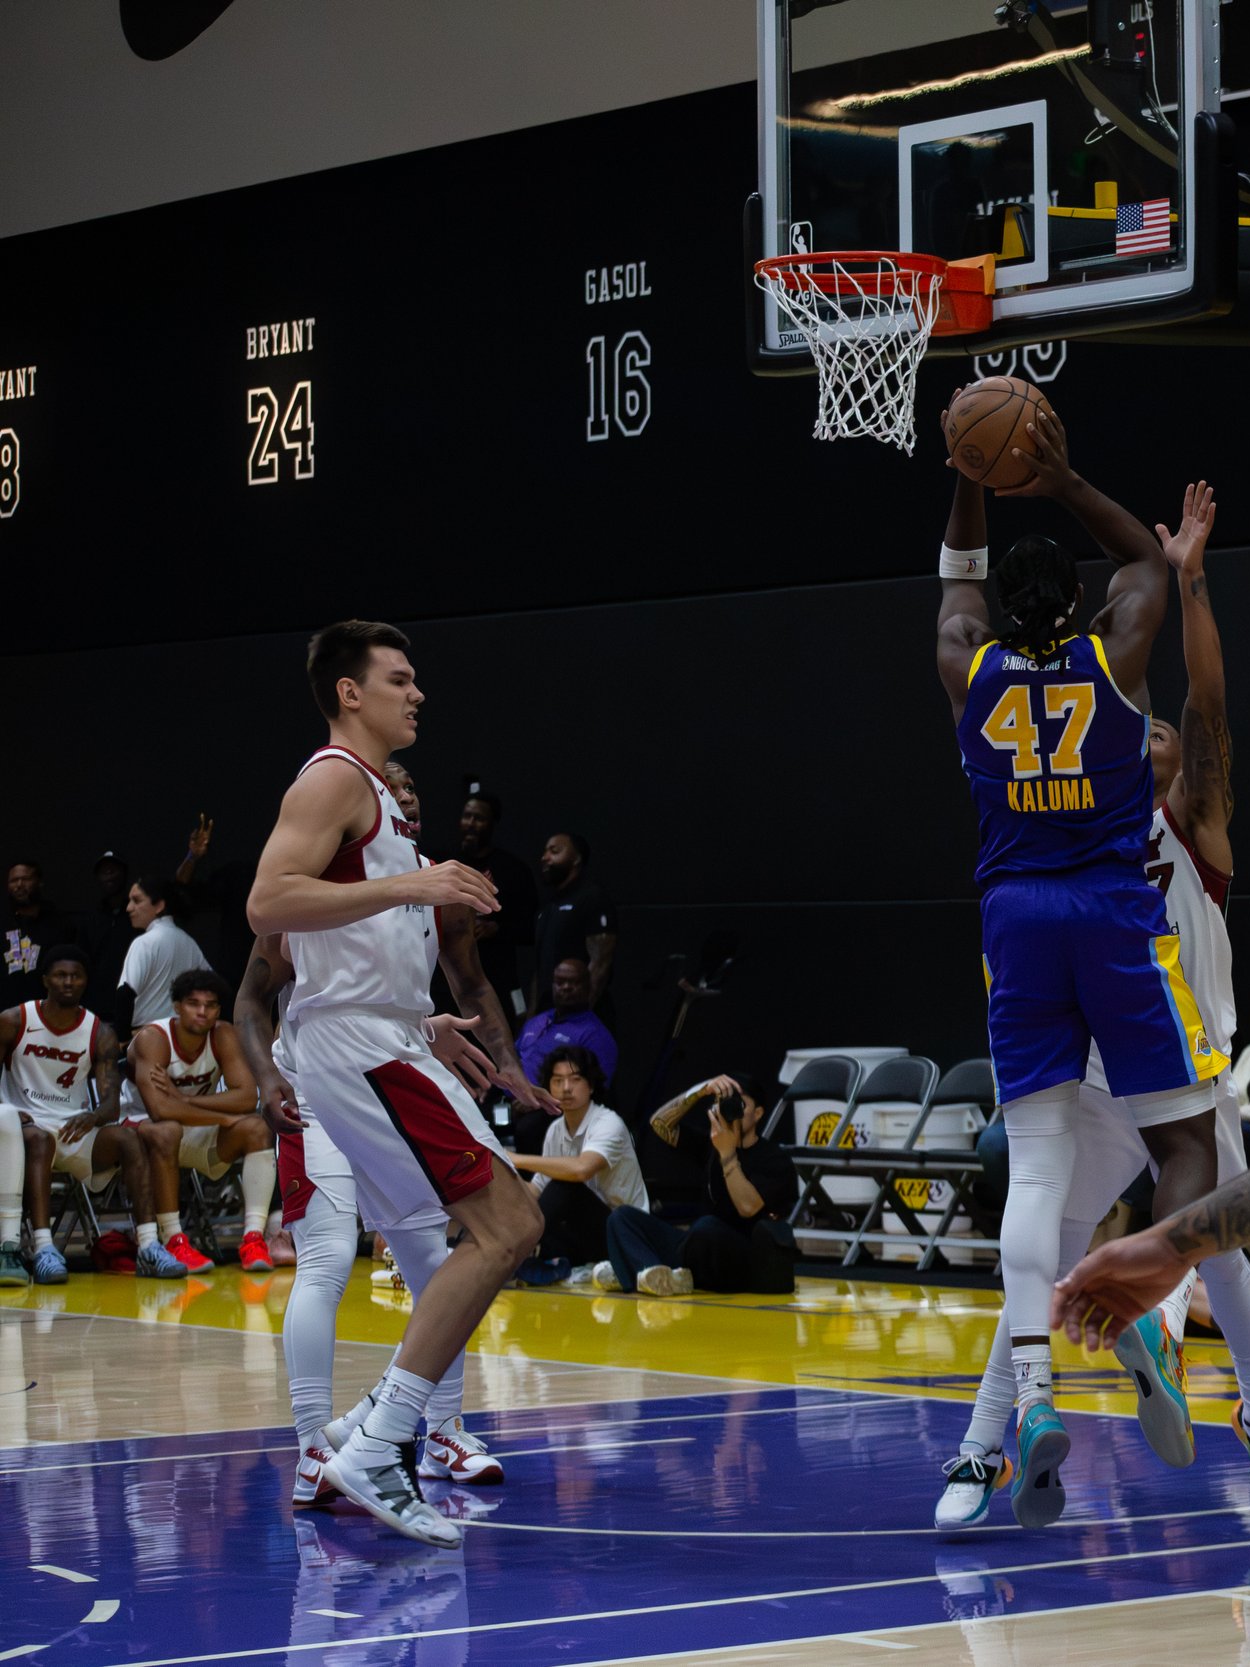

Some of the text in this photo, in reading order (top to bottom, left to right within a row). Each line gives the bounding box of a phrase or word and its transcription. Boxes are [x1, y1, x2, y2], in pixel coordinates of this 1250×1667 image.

[584, 261, 653, 305] GASOL
[246, 317, 316, 361] BRYANT
[585, 329, 652, 442] 16
[247, 380, 315, 486] 24
[0, 427, 20, 518] 8
[980, 682, 1097, 779] 47
[1007, 778, 1095, 813] KALUMA
[23, 1044, 86, 1063] FORCE
[56, 1067, 79, 1088] 4
